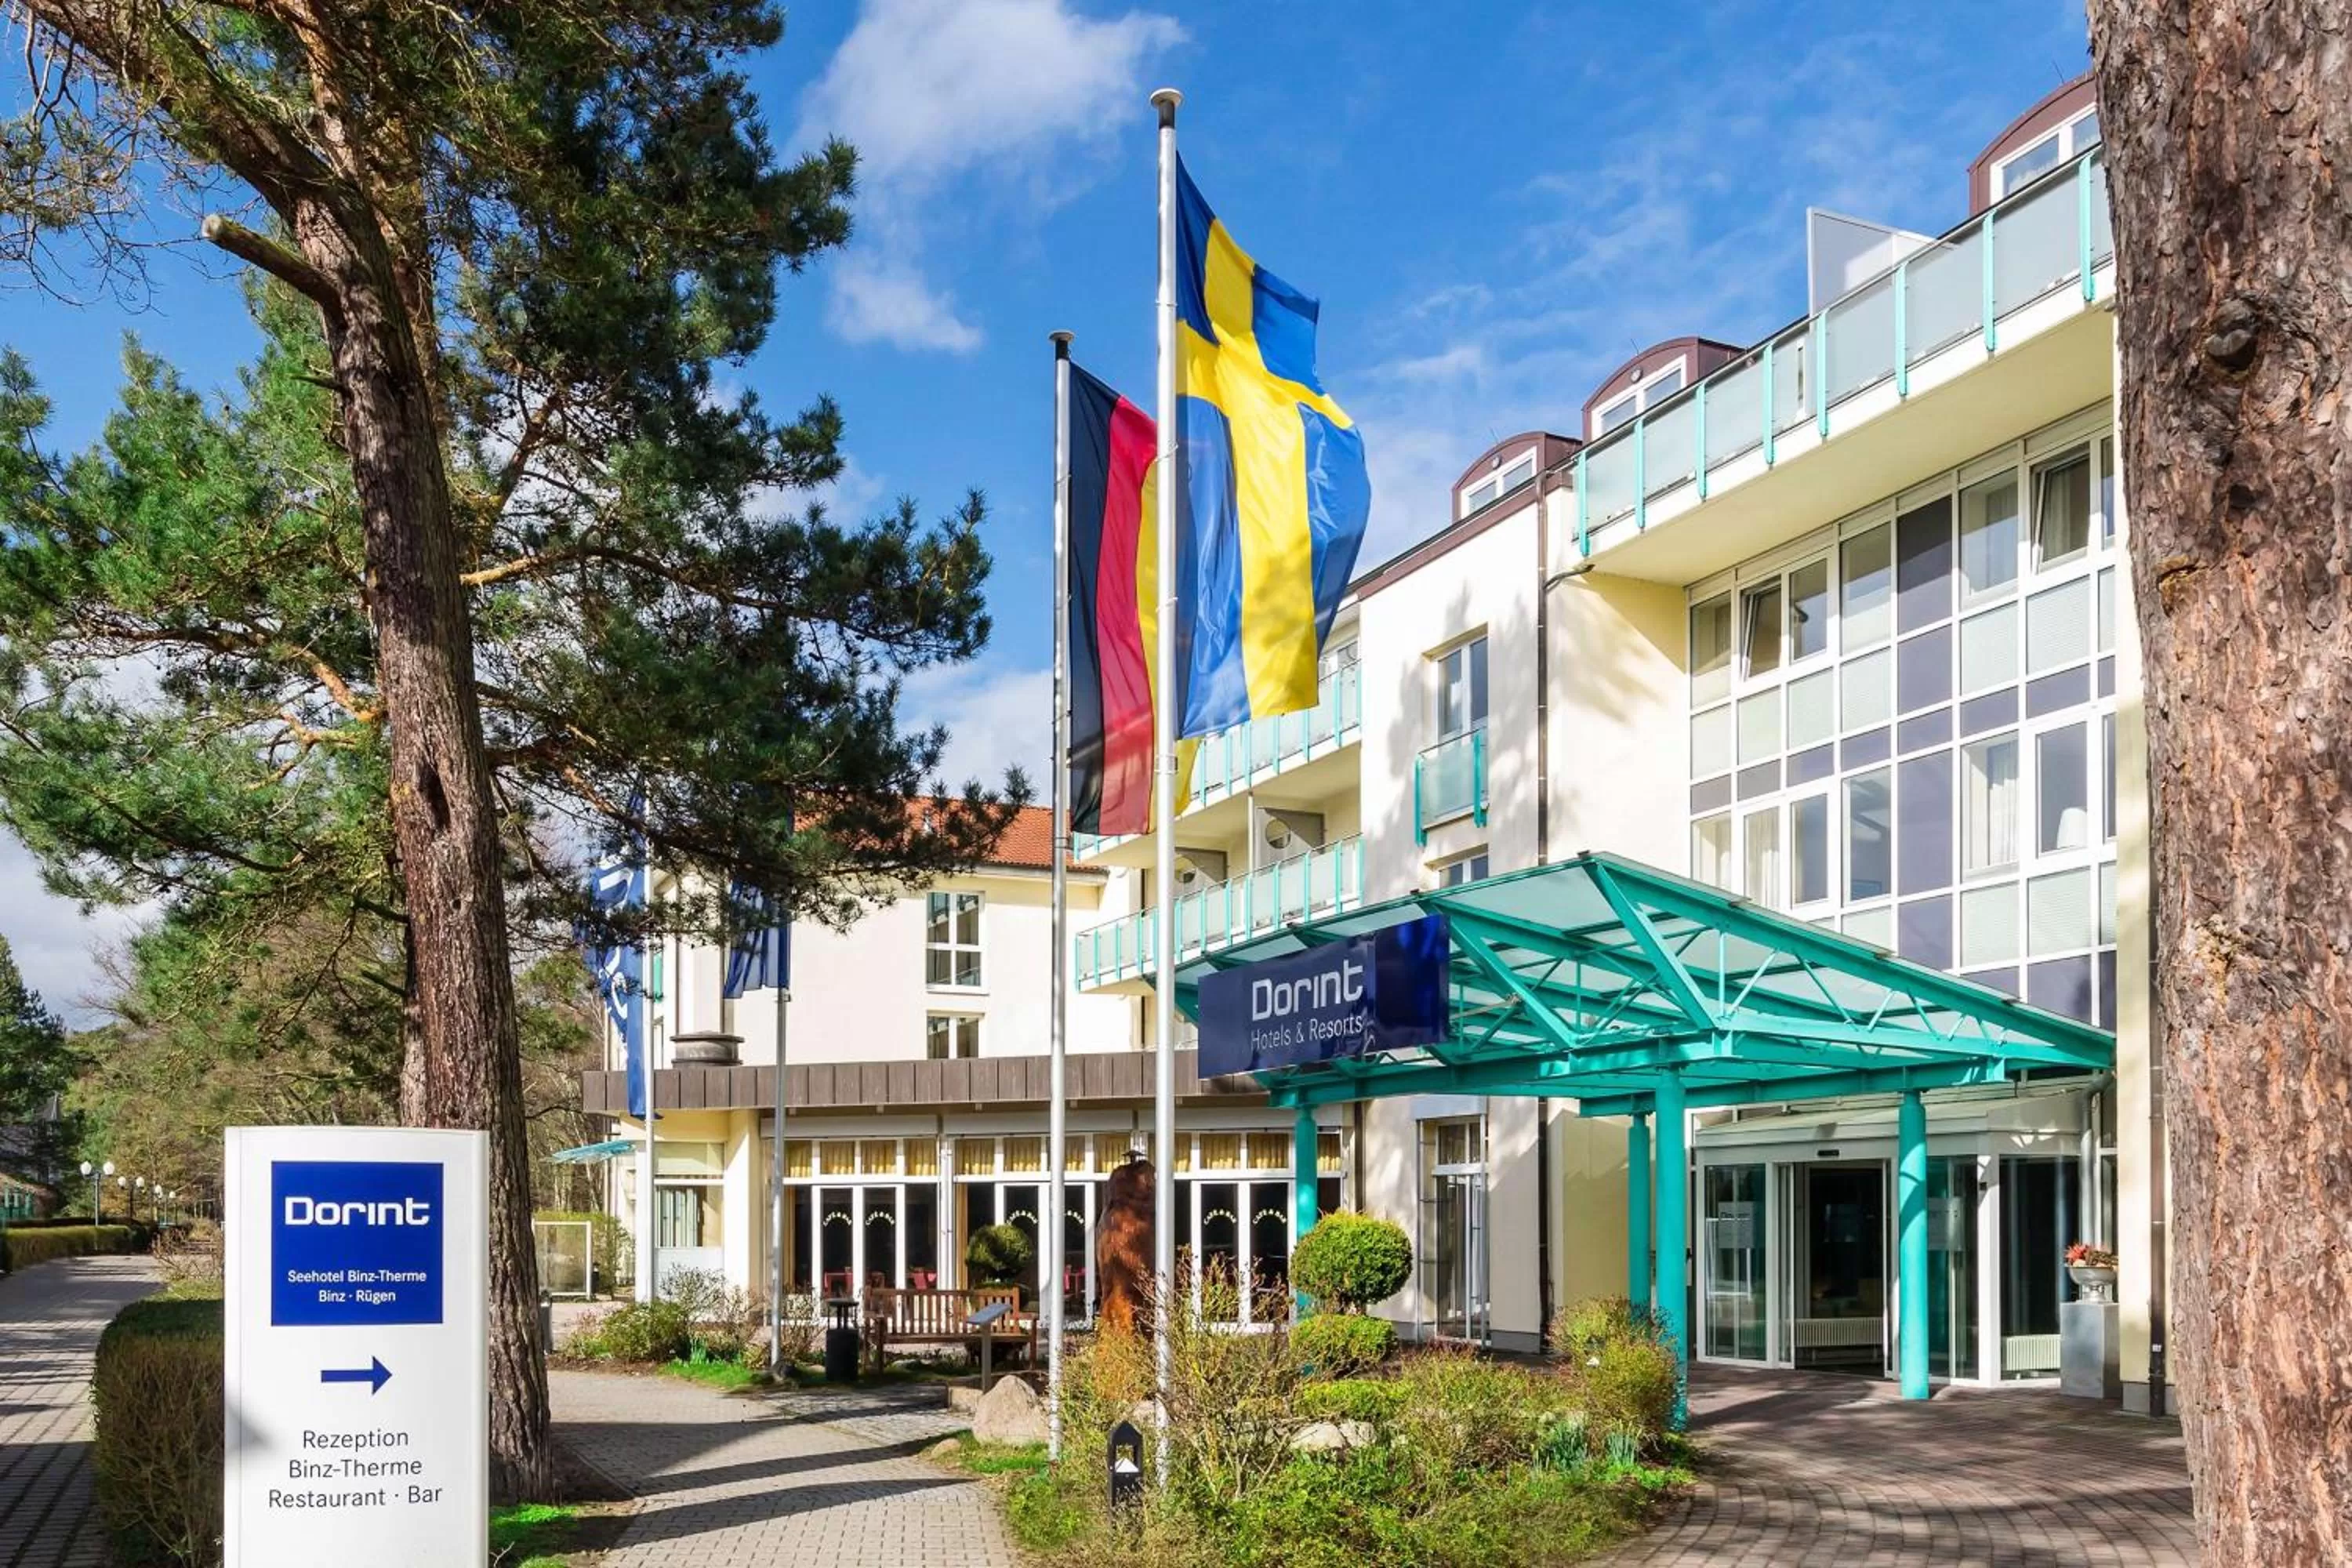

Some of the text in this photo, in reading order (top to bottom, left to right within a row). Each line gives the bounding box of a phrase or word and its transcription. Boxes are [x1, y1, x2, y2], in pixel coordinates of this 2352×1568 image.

[1252, 959, 1363, 1022] Dorint
[1250, 1013, 1363, 1051] Hotels & Resorts
[285, 1196, 430, 1225] Dorint
[288, 1269, 426, 1283] Seehotel Binz-Therme
[319, 1290, 346, 1302] Binz
[356, 1290, 396, 1305] Rügen
[303, 1428, 408, 1452] Rezeption
[289, 1459, 423, 1479] Binz-Therme
[269, 1489, 386, 1508] Restaurant
[408, 1485, 443, 1504] Bar
